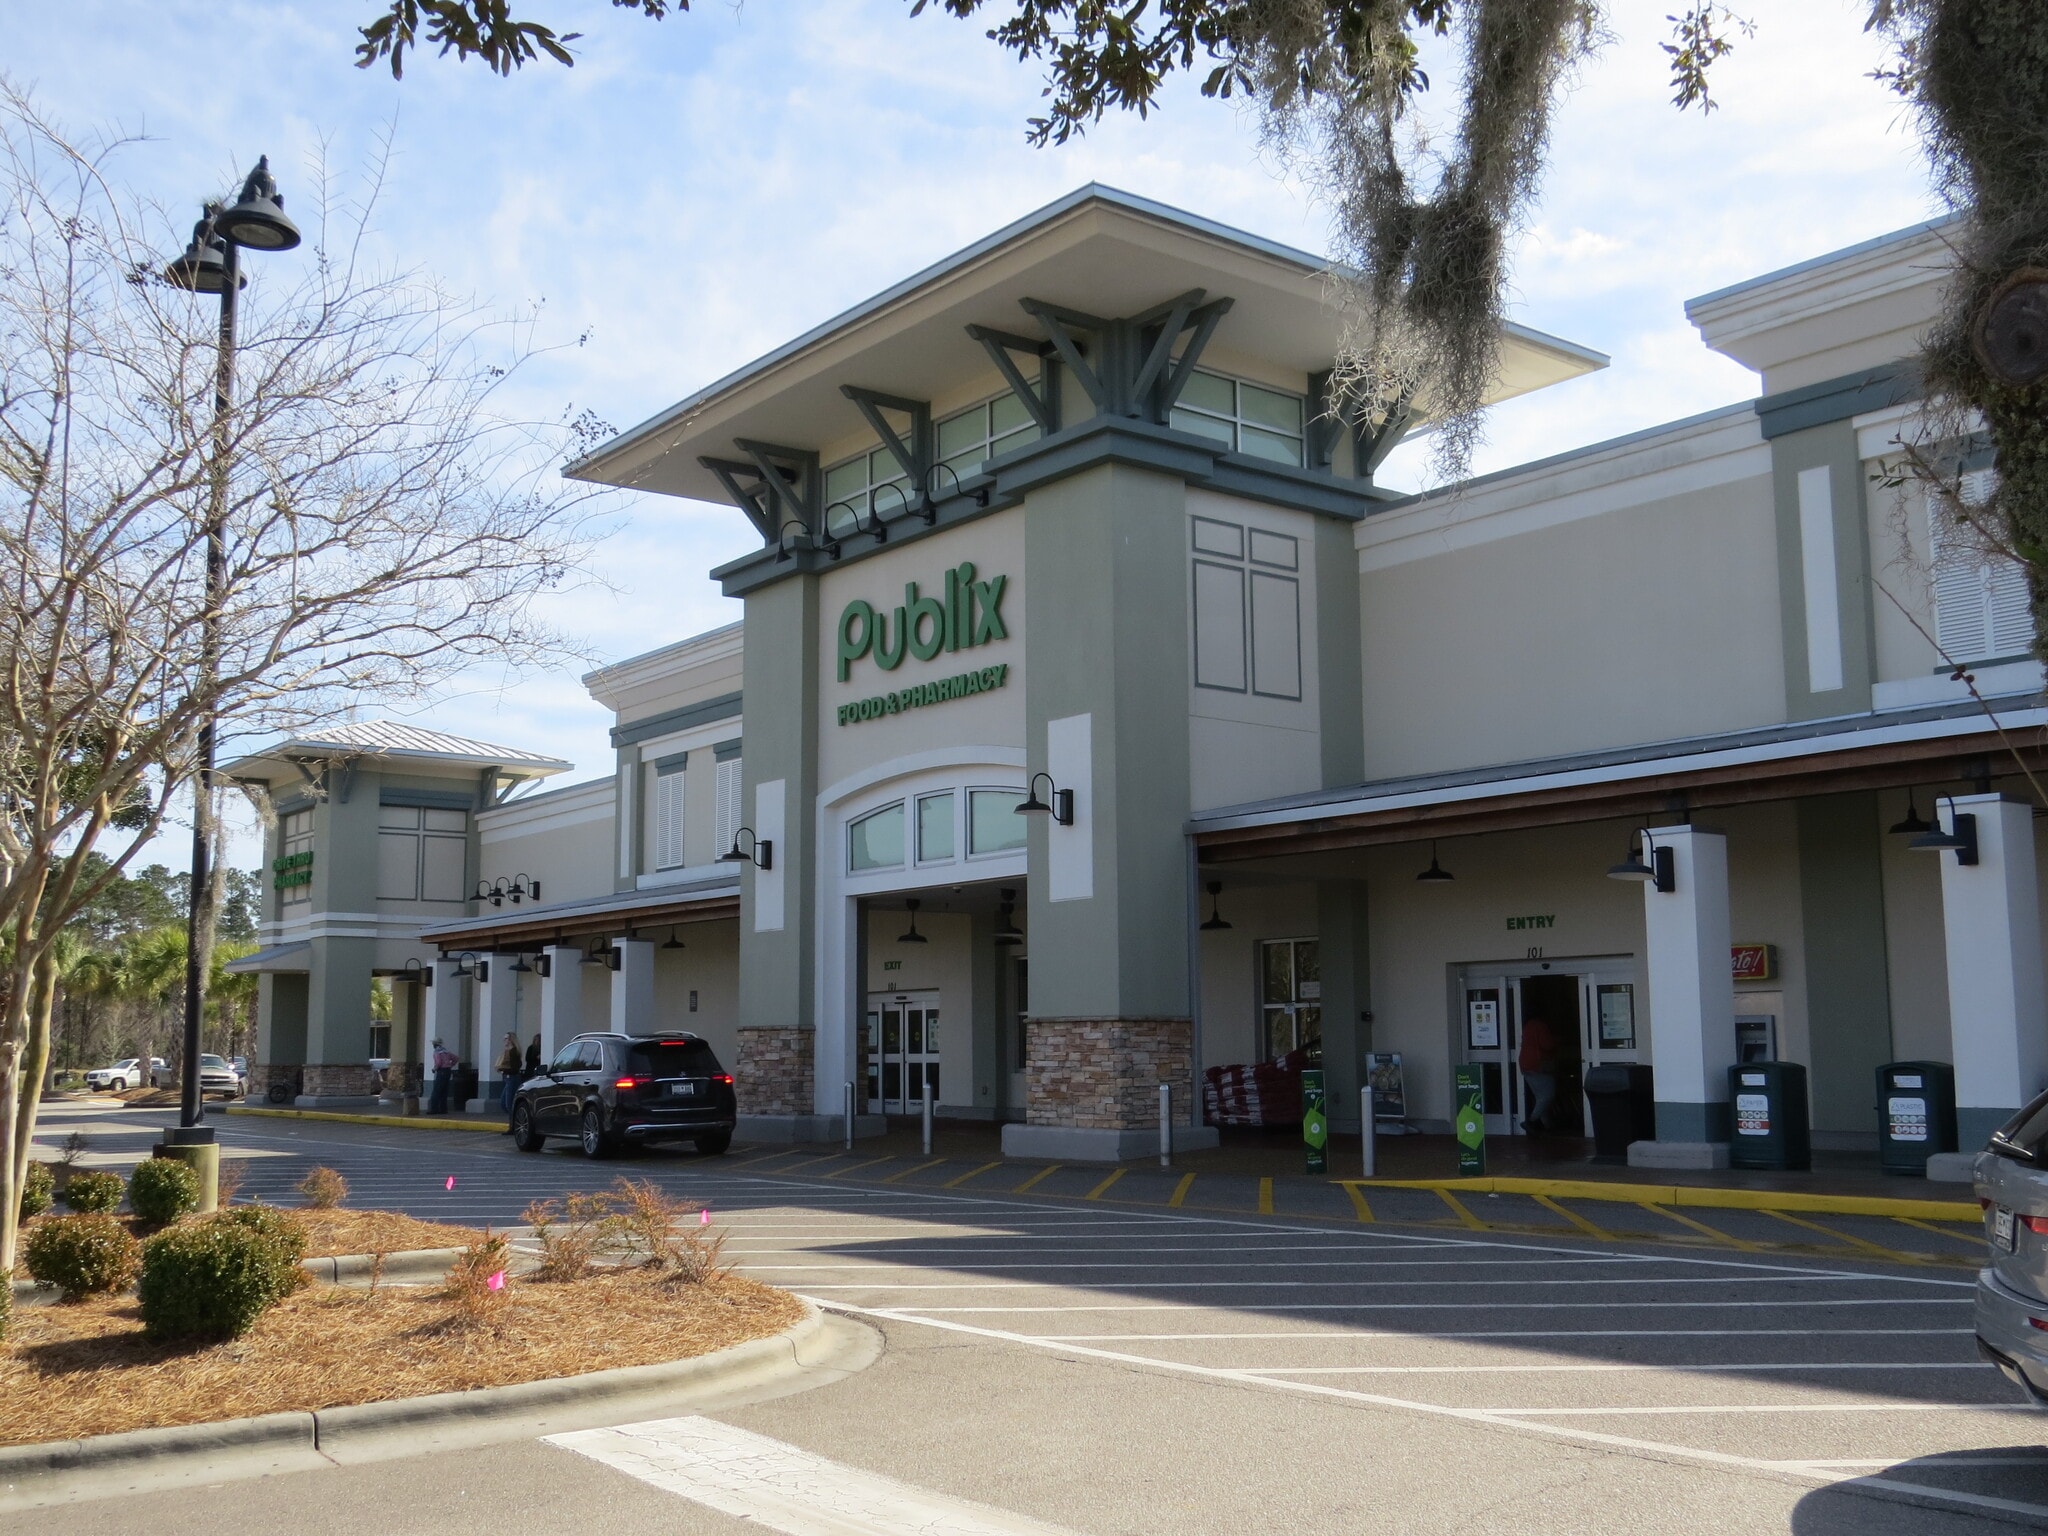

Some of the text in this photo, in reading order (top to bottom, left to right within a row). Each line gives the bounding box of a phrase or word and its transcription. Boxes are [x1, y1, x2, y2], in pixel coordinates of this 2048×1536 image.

[837, 696, 885, 727] FOOD
[898, 663, 1008, 712] PHARMACY
[1506, 914, 1556, 931] ENTRY
[1526, 945, 1543, 959] 101
[884, 960, 902, 971] EXIT
[1900, 1103, 1923, 1111] PLASTIC
